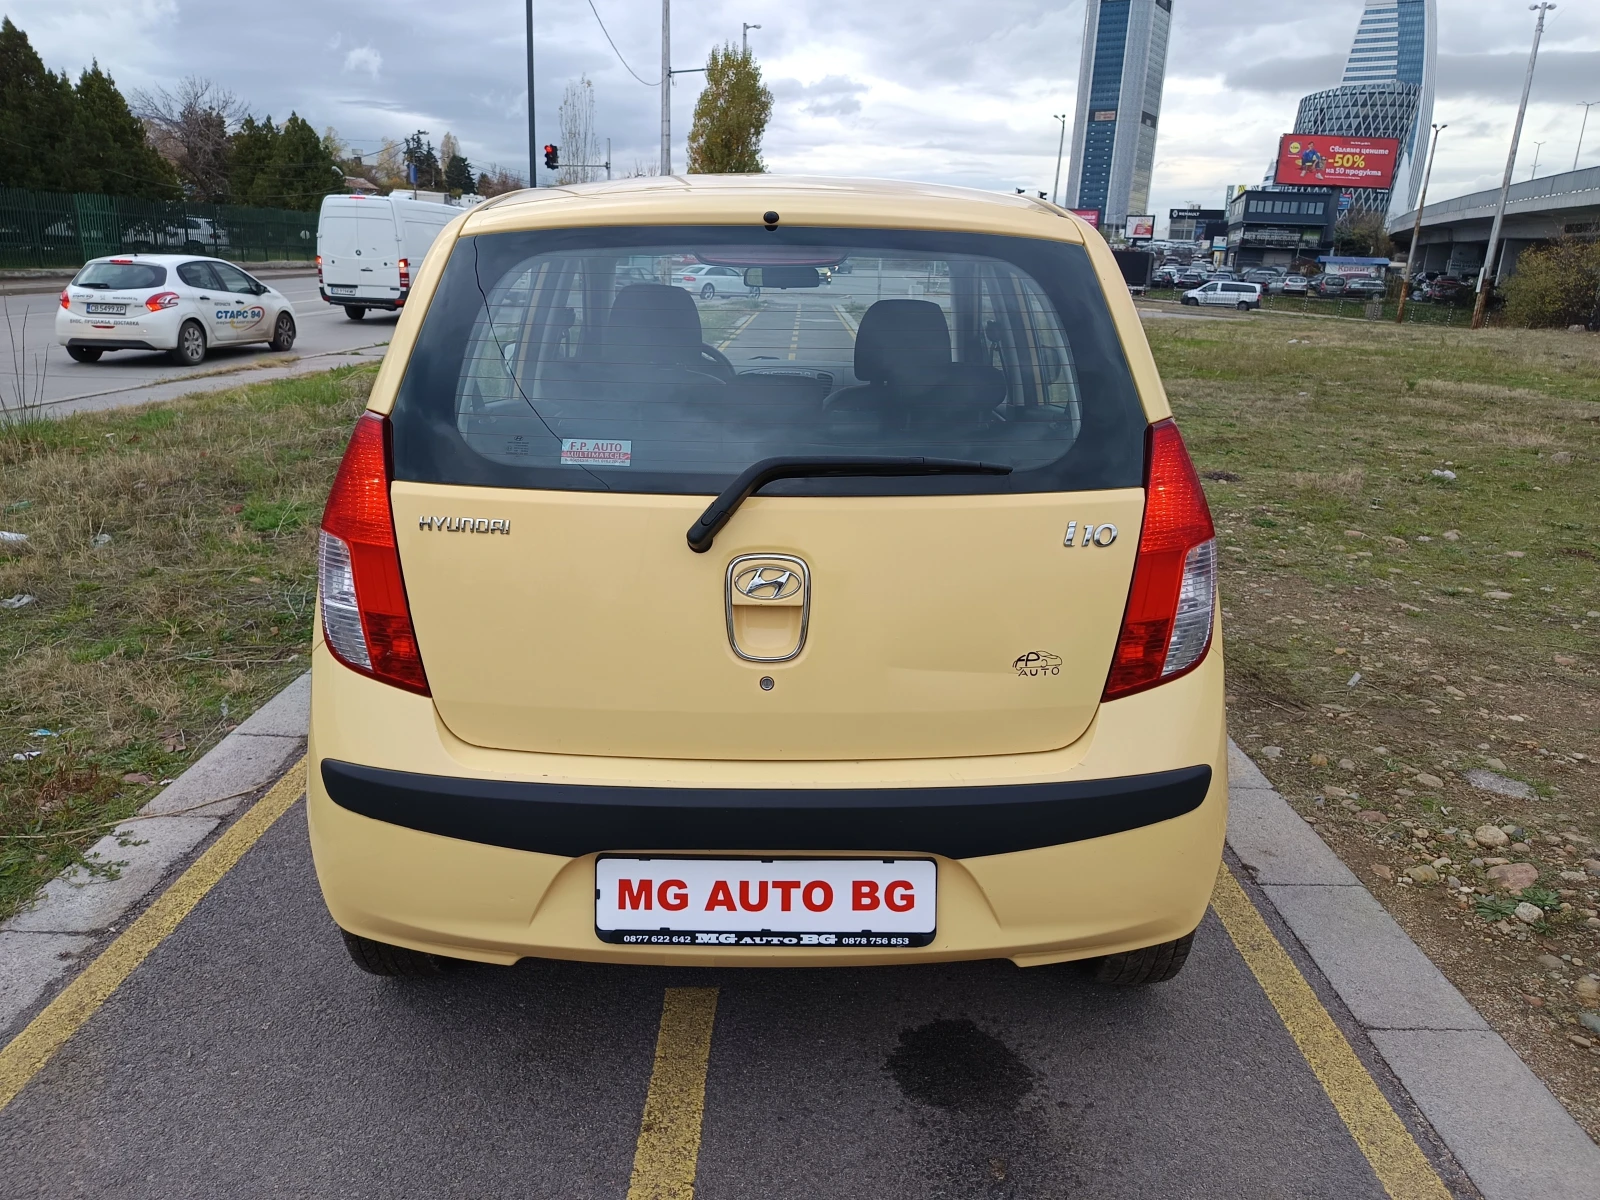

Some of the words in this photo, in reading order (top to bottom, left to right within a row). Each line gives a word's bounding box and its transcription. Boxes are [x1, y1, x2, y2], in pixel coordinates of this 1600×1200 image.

[1329, 145, 1360, 153] Сваляме
[1361, 147, 1389, 155] цените
[1328, 154, 1365, 168] -50%
[216, 310, 249, 319] СТАРС
[250, 310, 261, 319] 94
[570, 441, 589, 451] F.P.
[593, 442, 622, 451] AUTO
[567, 451, 625, 459] MULTIMARCHE
[419, 515, 511, 535] HYUNDAI
[1018, 666, 1060, 677] AUTO
[617, 878, 690, 912] MG
[704, 880, 835, 912] AUTO
[851, 880, 916, 912] BG
[623, 935, 649, 943] 0877
[651, 935, 670, 943] 622
[695, 933, 738, 944] MG
[800, 934, 838, 944] BG
[869, 937, 889, 945] 756
[890, 937, 910, 945] 853
